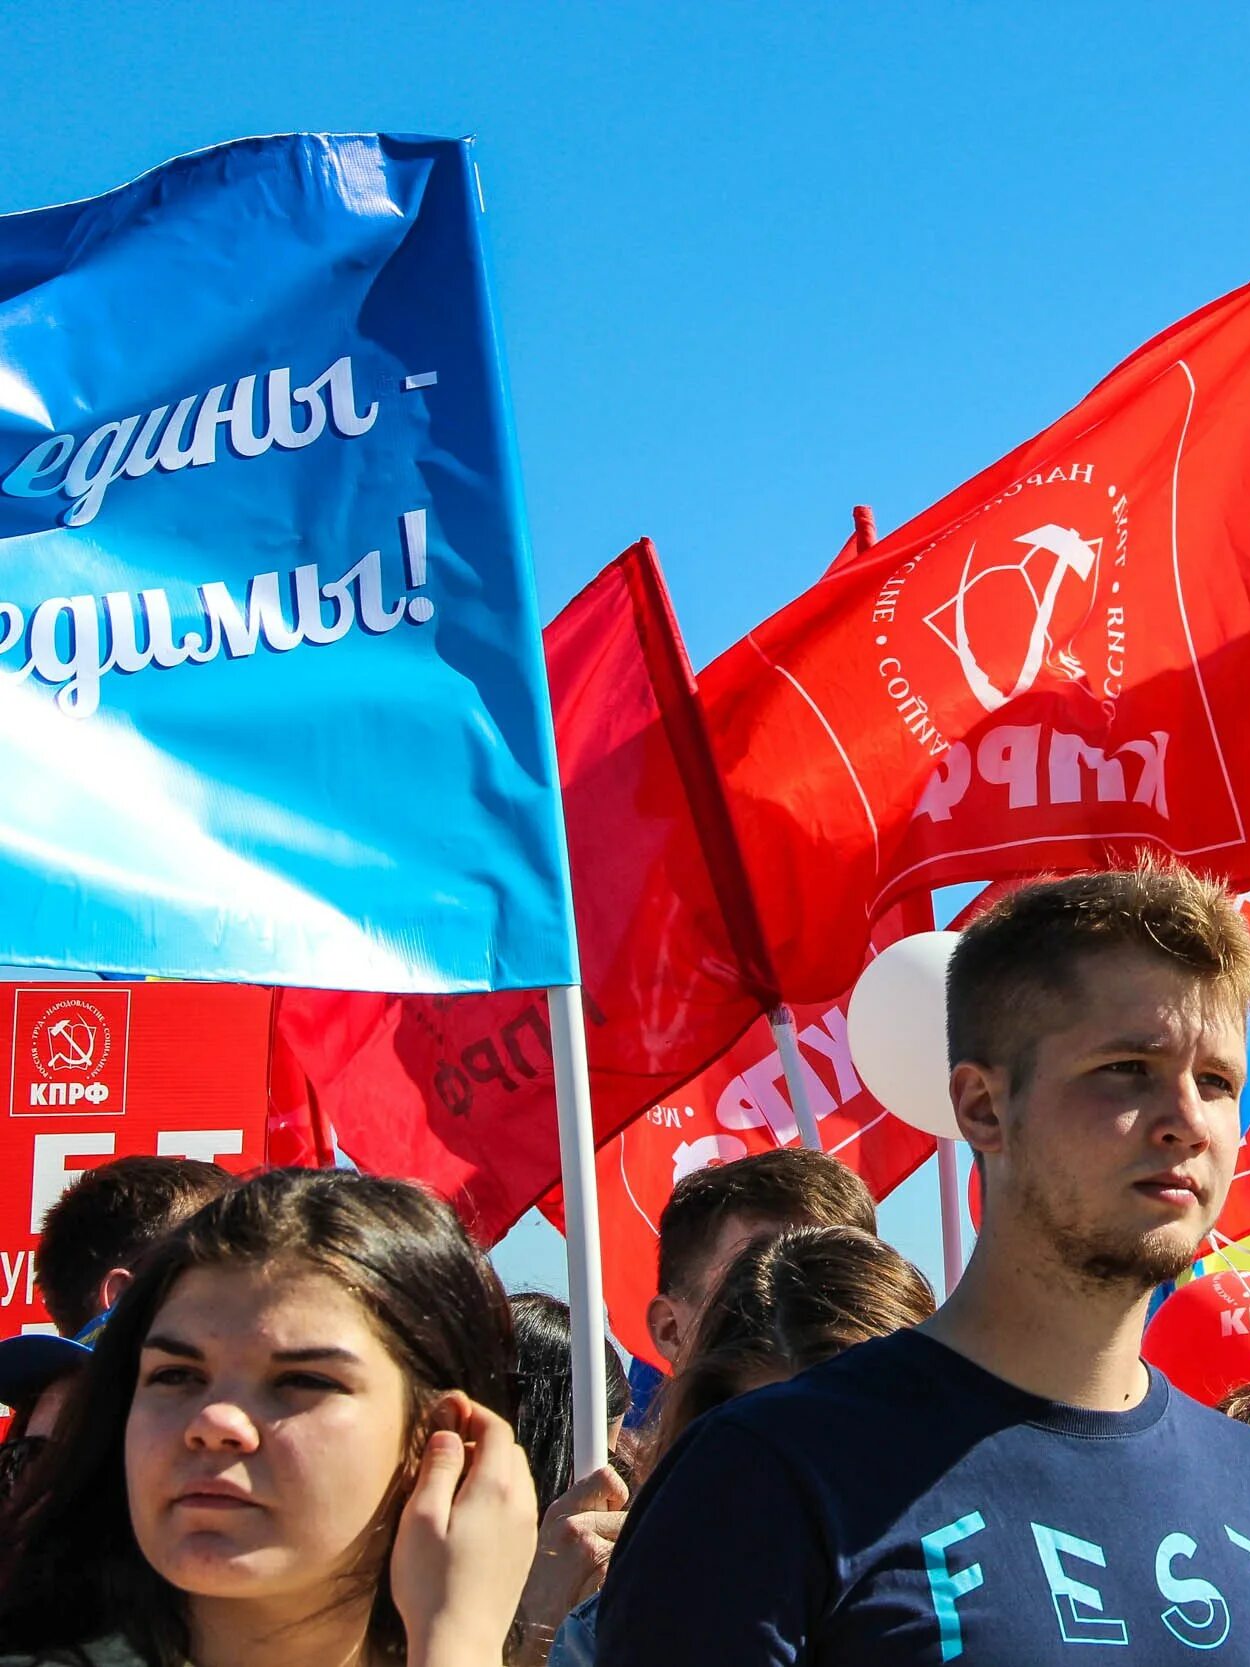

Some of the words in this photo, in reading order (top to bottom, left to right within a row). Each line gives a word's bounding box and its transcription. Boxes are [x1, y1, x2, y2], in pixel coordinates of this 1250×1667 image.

[2, 356, 379, 527] едины
[45, 999, 106, 1023] НАРОДОВЛАСТИЕ
[32, 1020, 46, 1040] ТРУД
[31, 1047, 49, 1078] РОССИЯ
[30, 1082, 109, 1106] КПРФ
